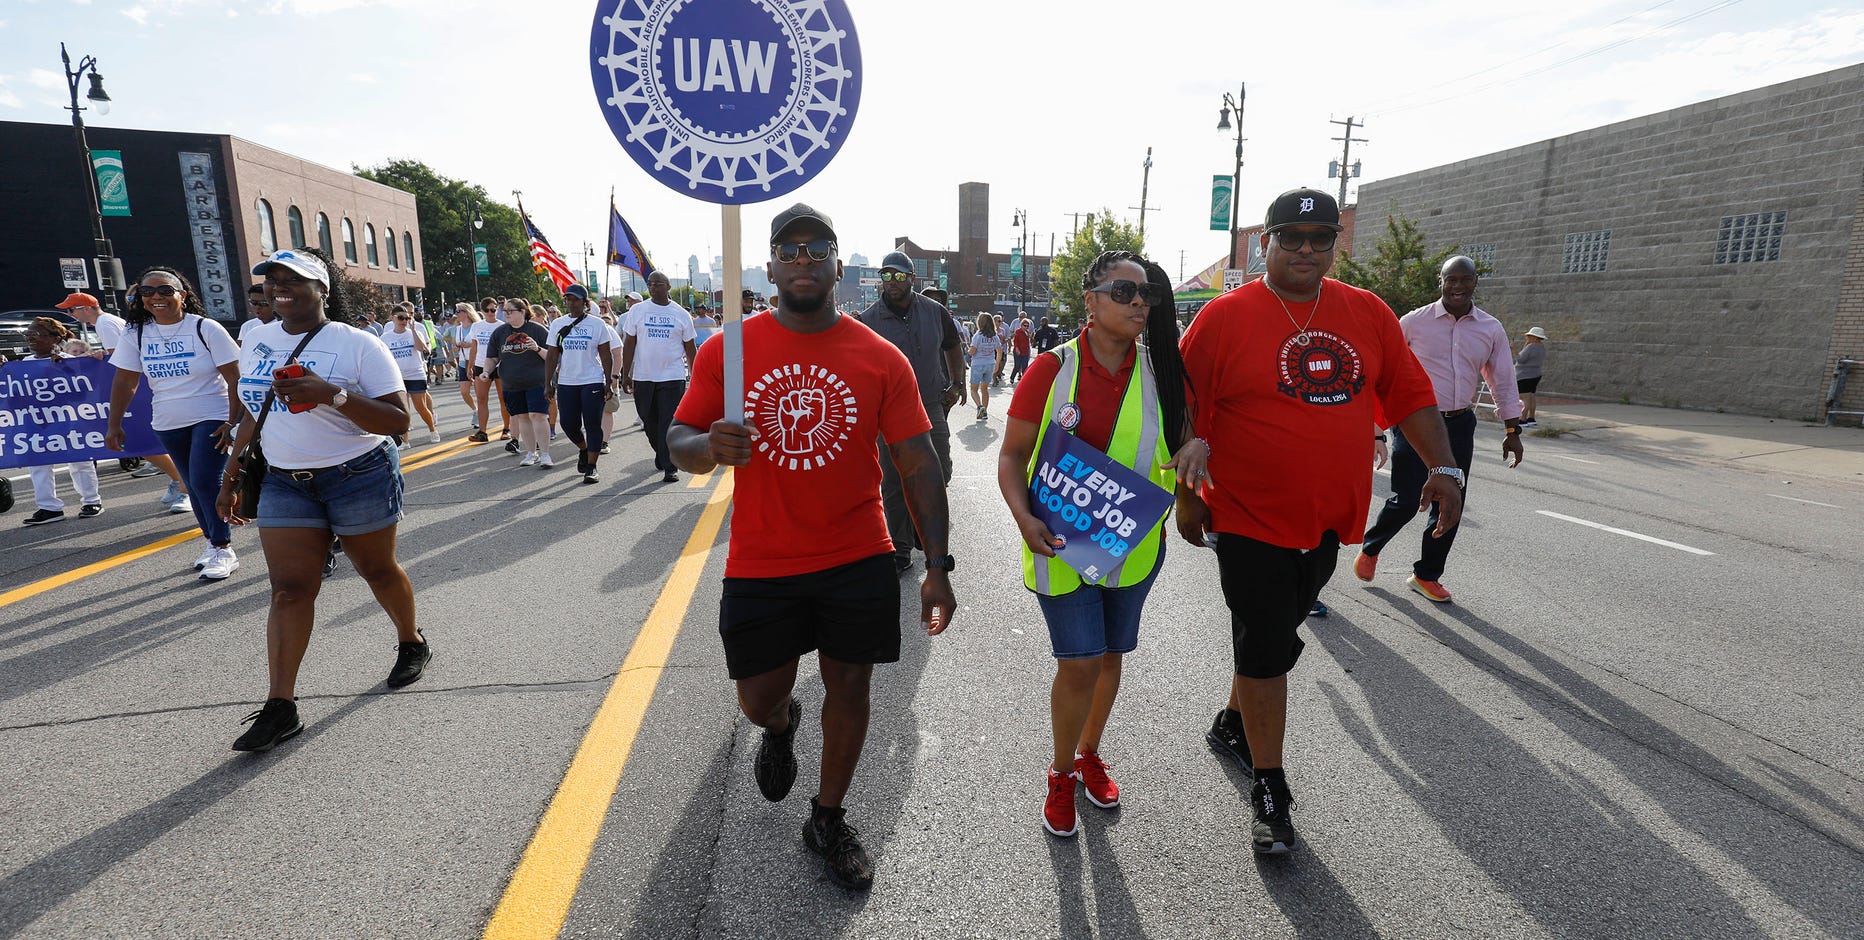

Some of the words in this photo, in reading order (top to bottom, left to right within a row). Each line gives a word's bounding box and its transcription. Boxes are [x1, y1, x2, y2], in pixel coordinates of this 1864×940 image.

[643, 0, 670, 41] AEROSPA
[640, 45, 663, 111] AUTOMOBILE,
[673, 37, 778, 94] UAW
[801, 49, 812, 97] WORKERS
[796, 99, 806, 113] OF
[661, 113, 690, 141] UNITED
[764, 113, 797, 145] AMERICA
[1299, 197, 1315, 215] D
[190, 165, 225, 308] BARBERSHOP
[659, 316, 670, 324] SOS
[148, 343, 160, 355] MI
[164, 341, 185, 354] SOS
[1280, 360, 1293, 385] LABOR
[1304, 331, 1338, 341] RONGER
[1340, 340, 1357, 357] THAN
[1352, 360, 1360, 379] EVER
[147, 360, 189, 371] SERVICE
[149, 368, 190, 379] DRIVEN
[250, 359, 277, 377] MI
[1308, 360, 1331, 372] UAW
[744, 363, 801, 419] STRONGER
[809, 364, 858, 424] TOGETHER
[1309, 395, 1332, 403] LOCAL
[13, 430, 105, 455] State
[1056, 452, 1136, 506] EVERY
[1038, 460, 1092, 507] AUTO
[1092, 502, 1137, 538] JOB
[1038, 488, 1092, 532] GOOD
[1089, 527, 1129, 558] JOB
